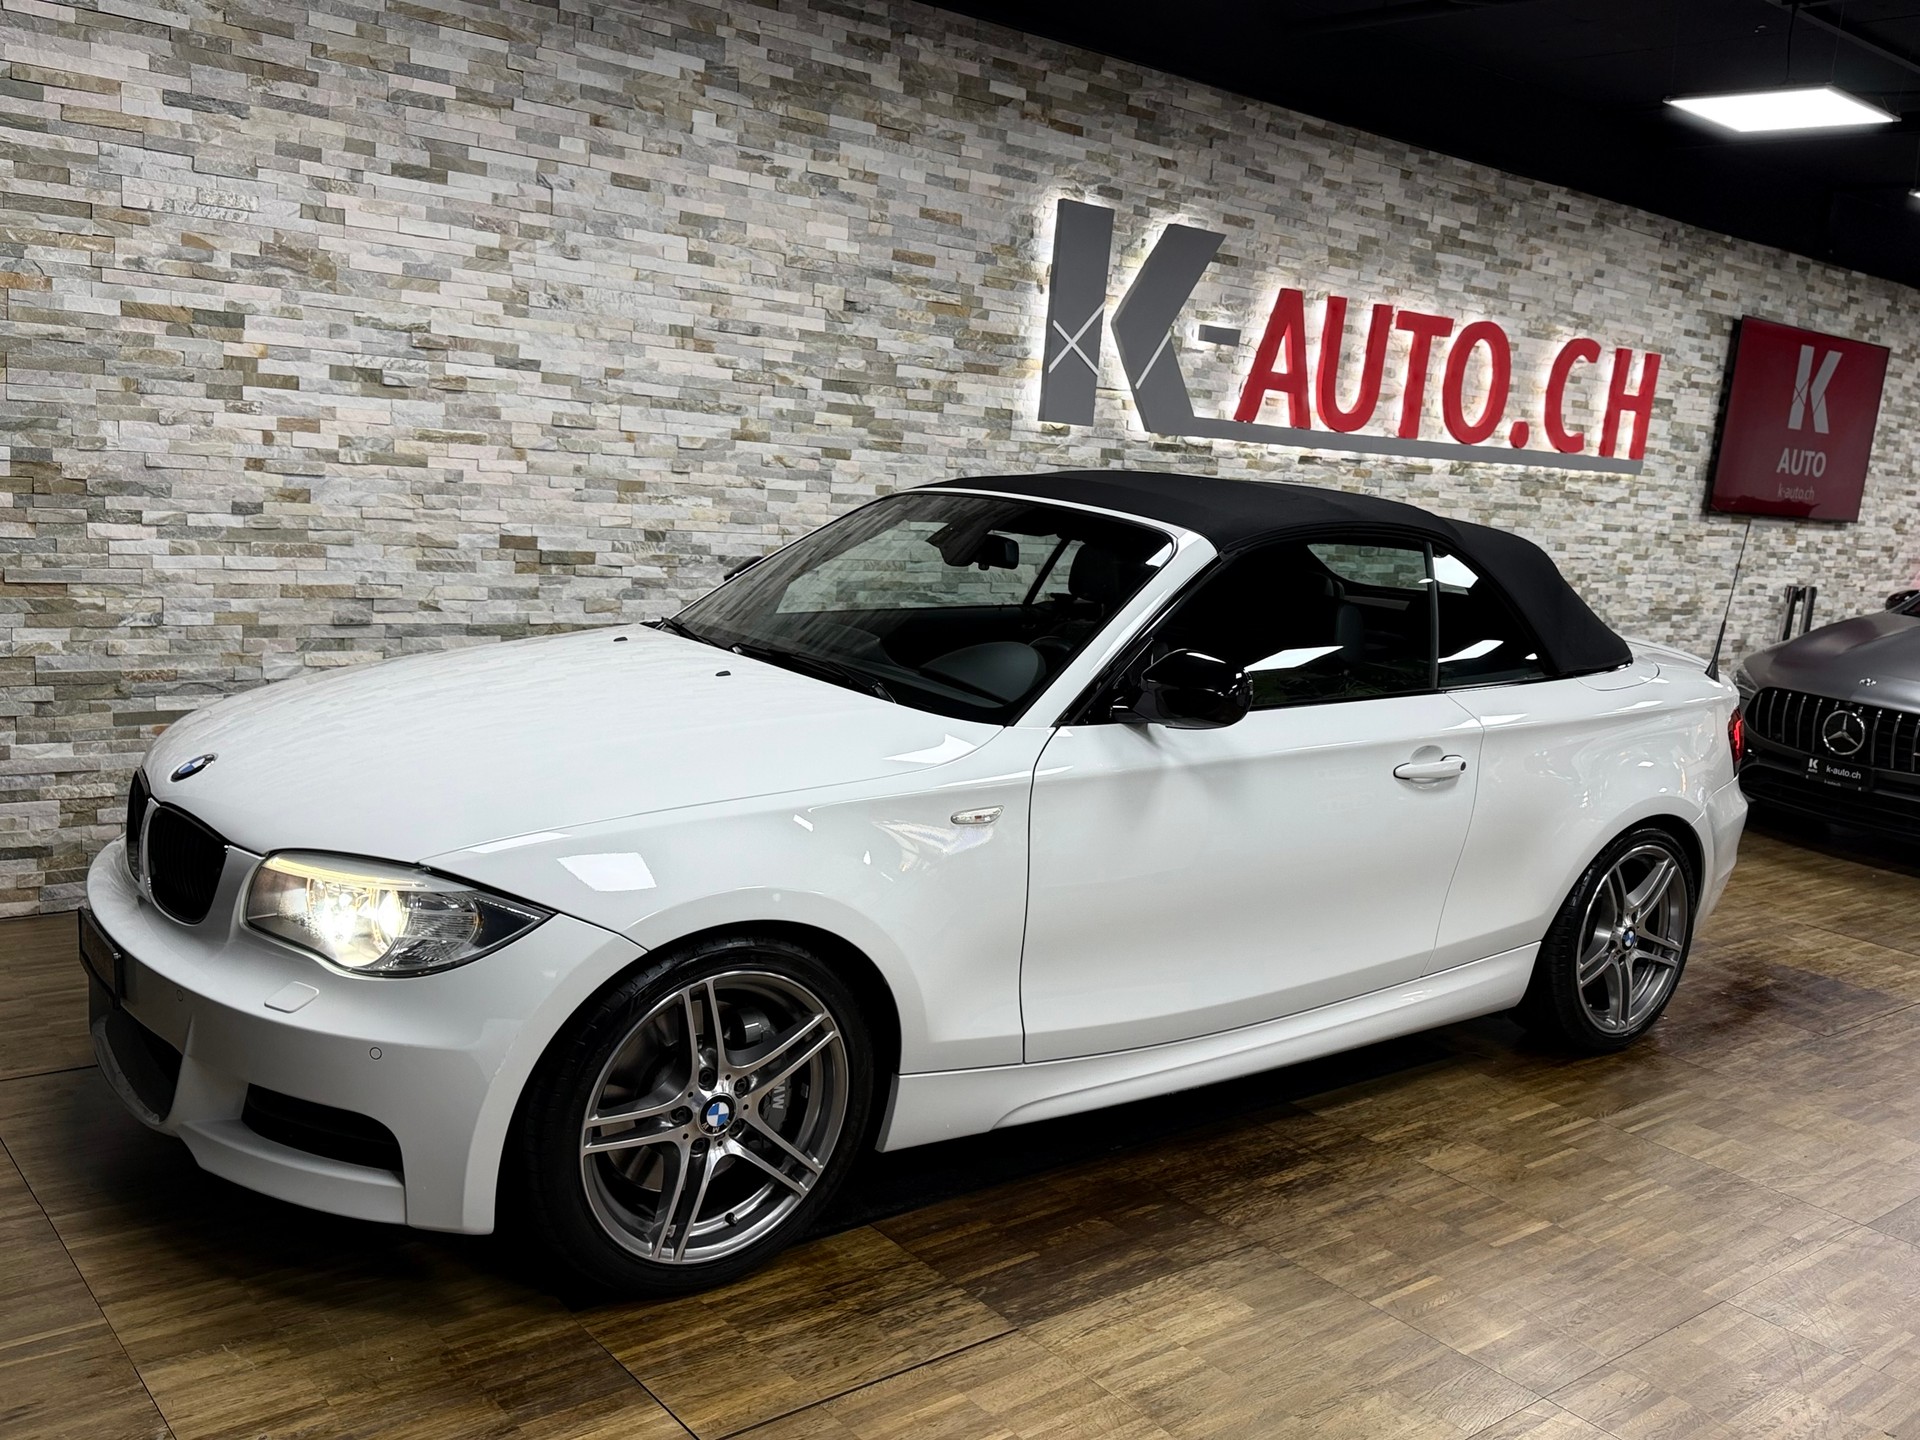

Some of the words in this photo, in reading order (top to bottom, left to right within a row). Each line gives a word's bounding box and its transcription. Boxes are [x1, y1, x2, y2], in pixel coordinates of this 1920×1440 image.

[1038, 198, 1661, 461] K-AUTO.CH
[1788, 344, 1843, 434] K
[1776, 448, 1827, 478] AUTO
[1777, 483, 1815, 500] k-auto.ch
[1808, 758, 1819, 769] K
[1826, 764, 1861, 779] k-auto.ch
[772, 1079, 786, 1109] MW
